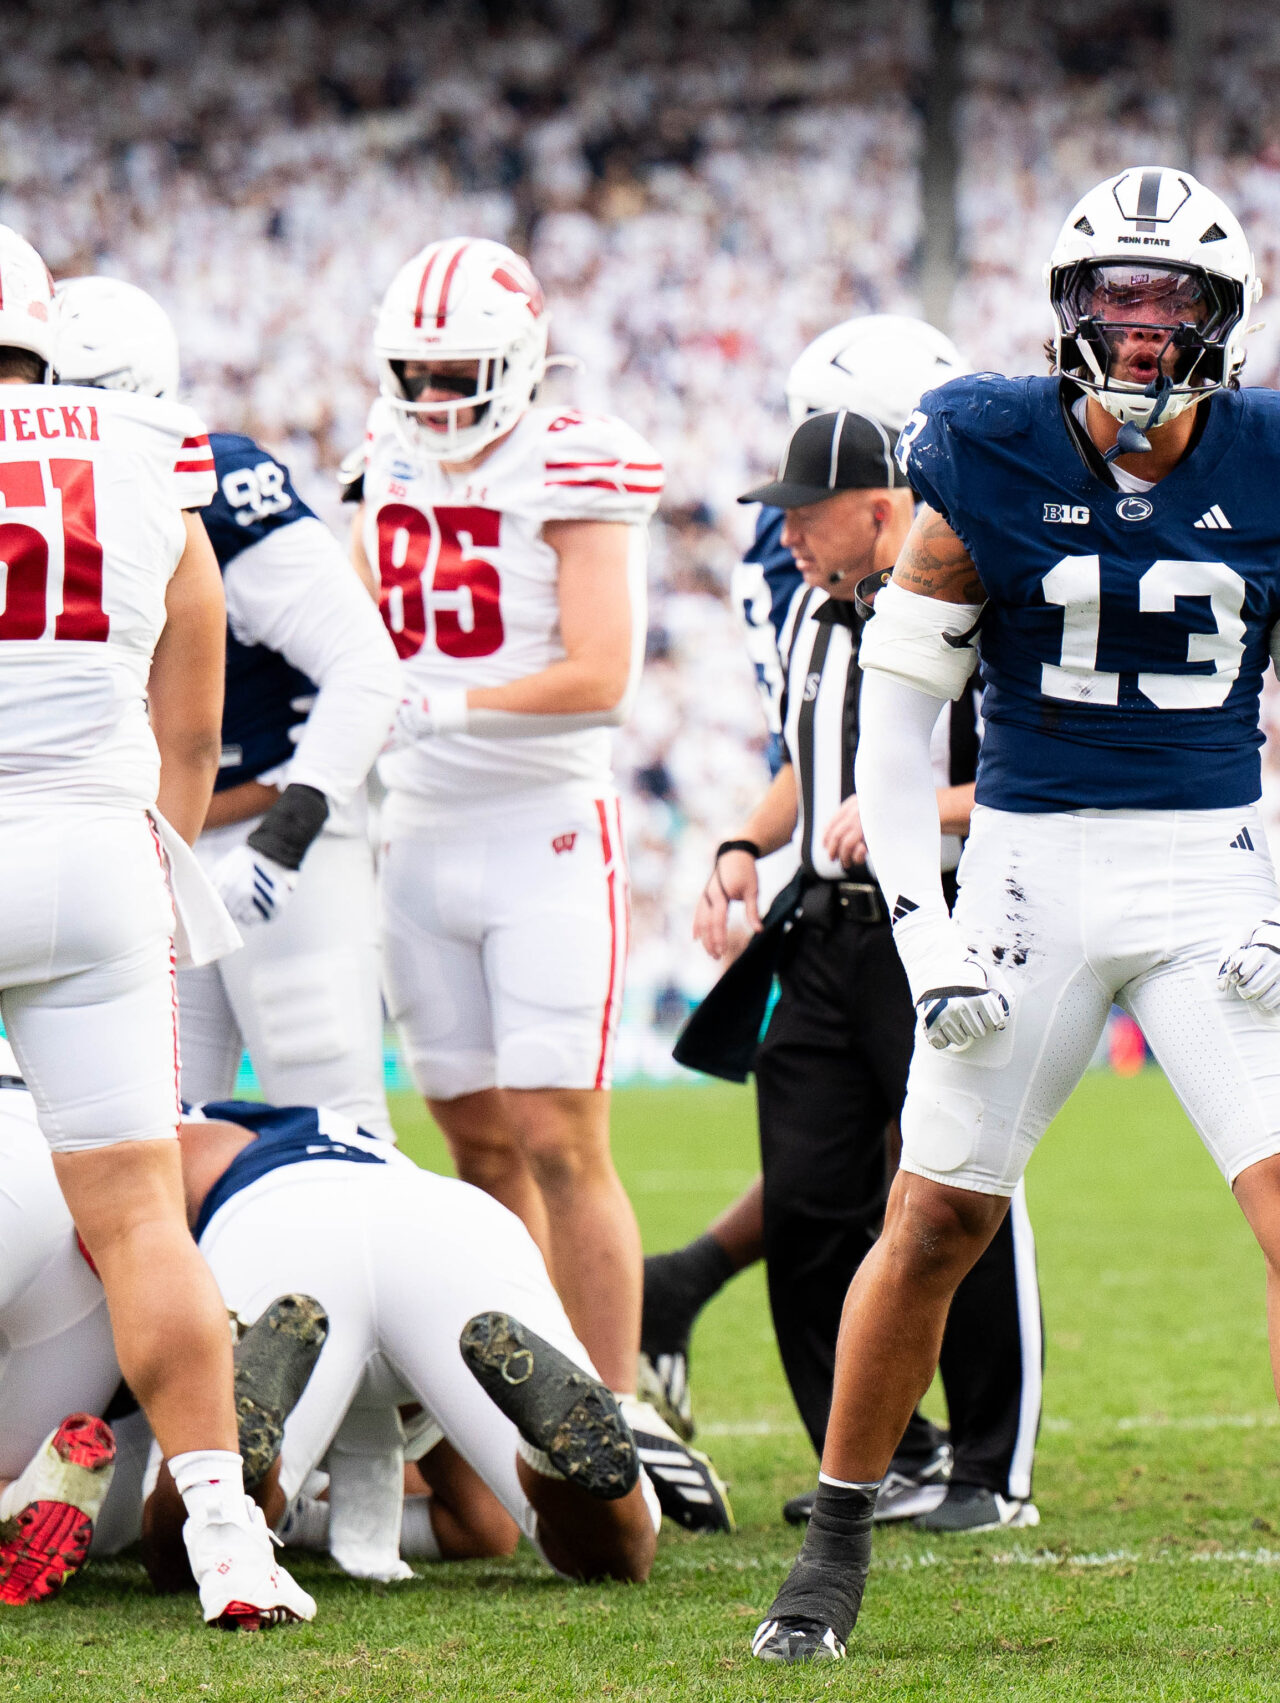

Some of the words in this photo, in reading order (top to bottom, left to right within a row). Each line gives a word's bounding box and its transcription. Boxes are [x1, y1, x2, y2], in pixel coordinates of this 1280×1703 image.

[1117, 236, 1141, 244] PENN
[1143, 237, 1170, 247] STATE
[0, 406, 100, 441] ECKI
[377, 503, 504, 660] 85
[1041, 554, 1248, 710] 13
[803, 672, 822, 702] S
